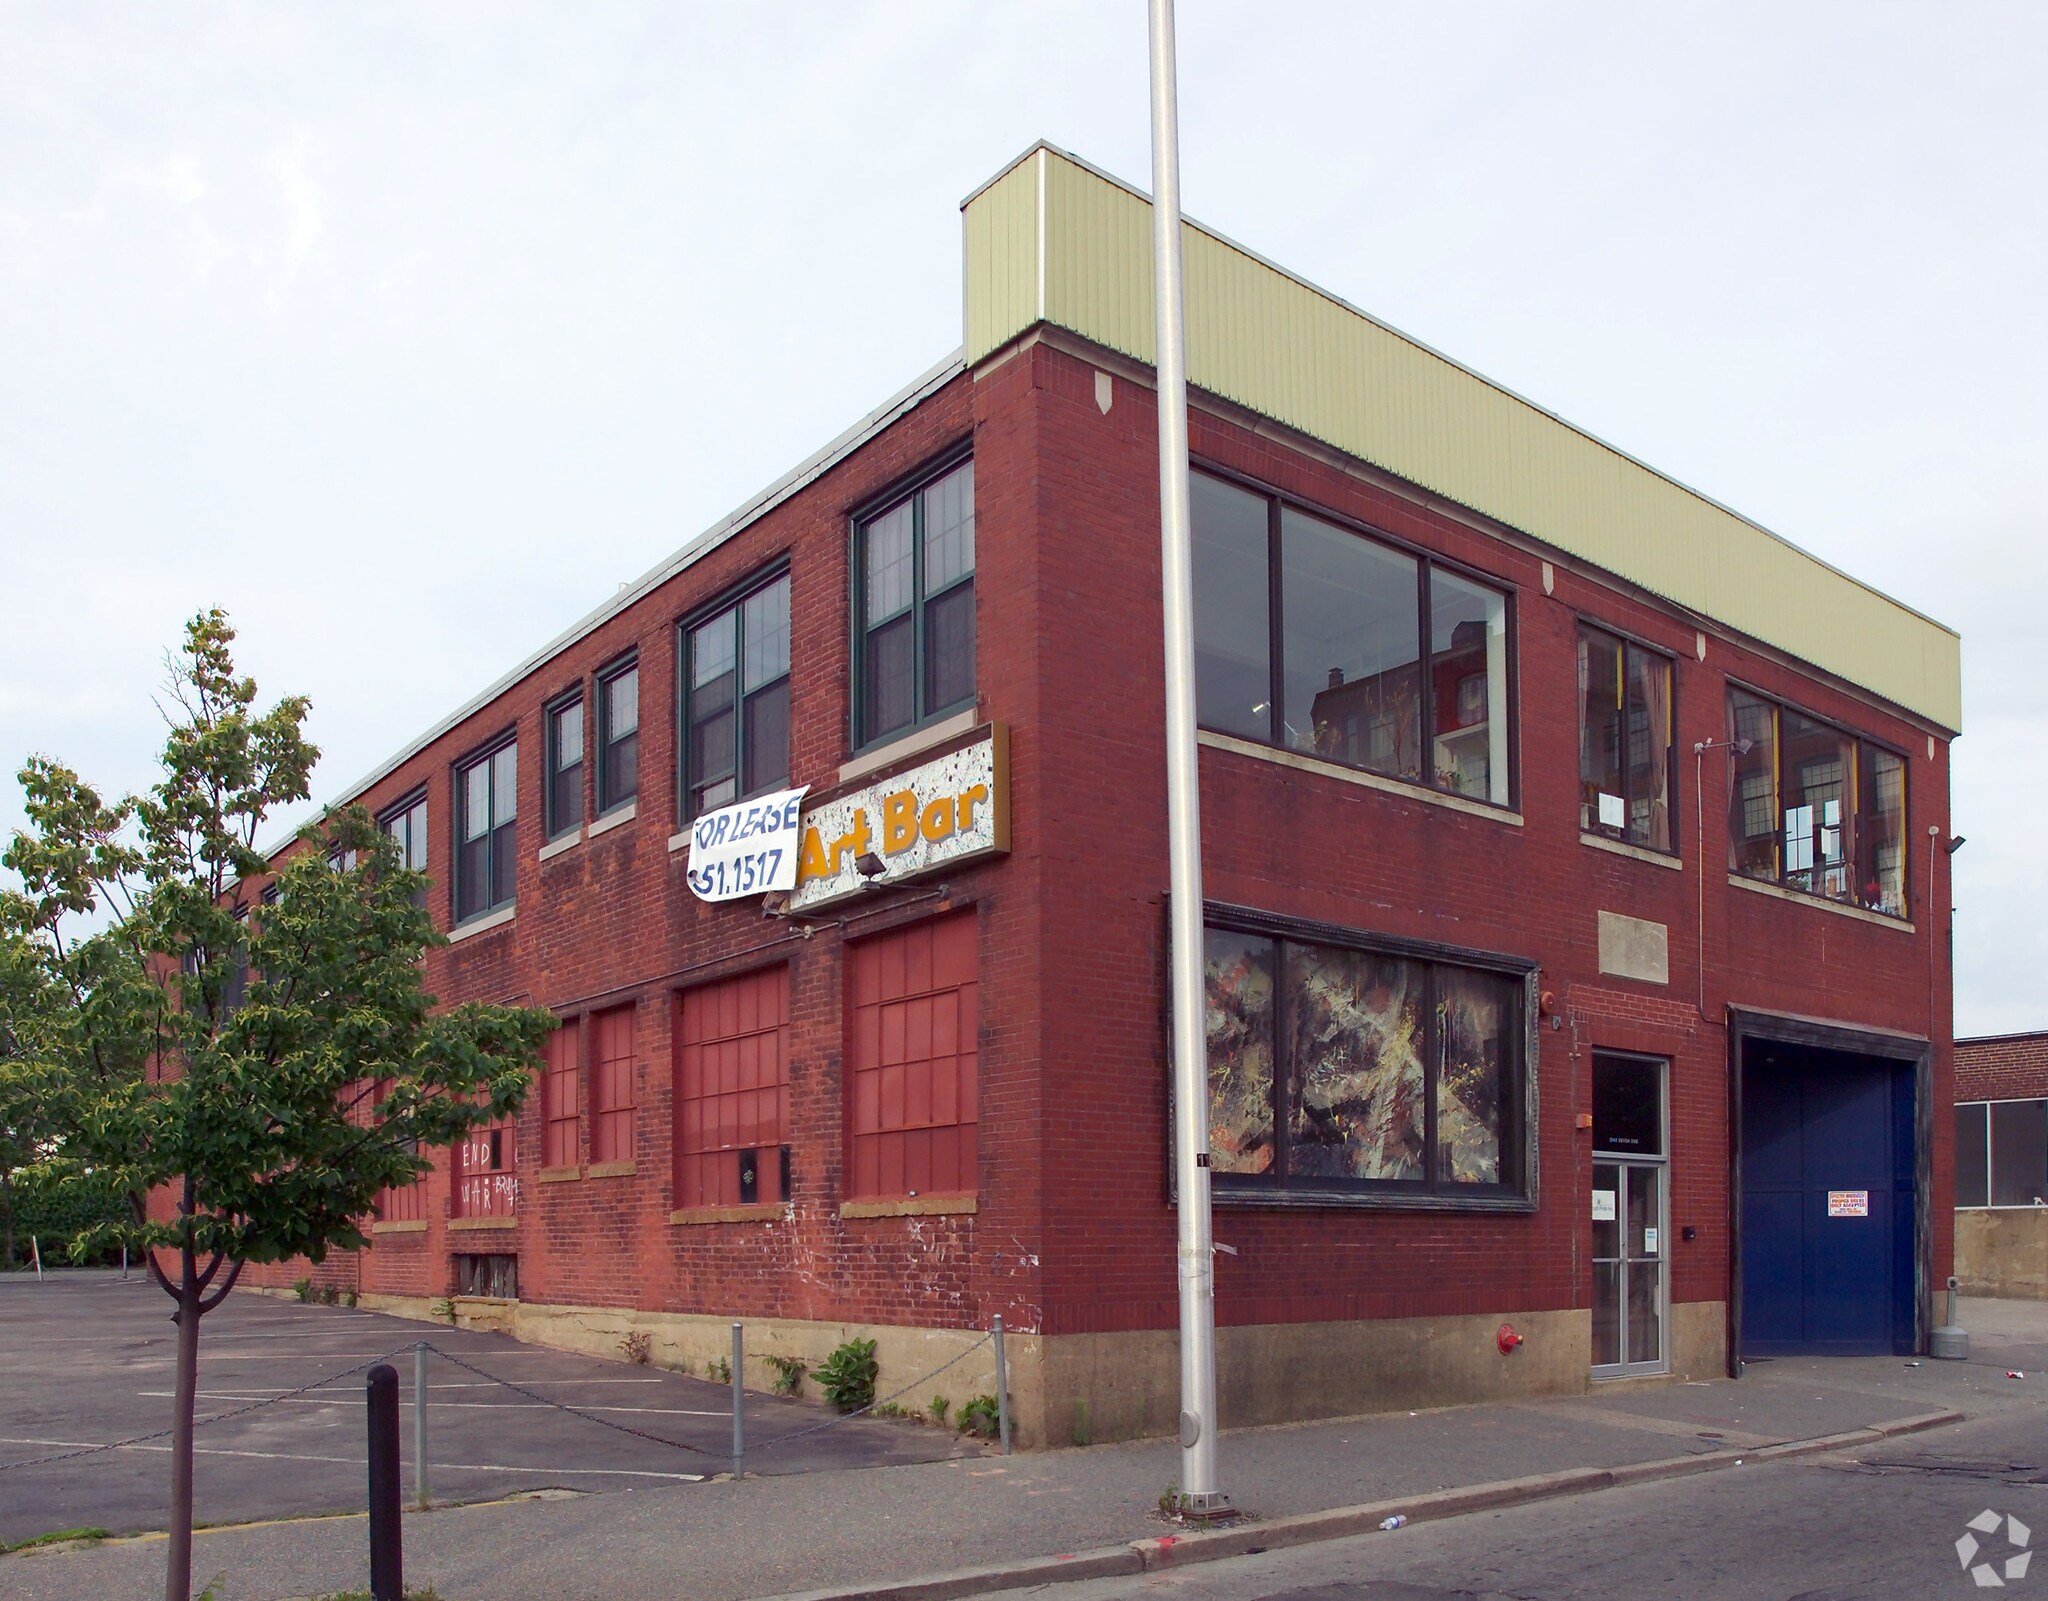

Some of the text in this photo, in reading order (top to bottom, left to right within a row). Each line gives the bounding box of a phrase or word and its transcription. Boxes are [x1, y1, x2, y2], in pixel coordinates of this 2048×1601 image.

[728, 795, 801, 842] LEASE
[797, 783, 989, 882] Art Bar
[462, 1143, 490, 1167] END
[461, 1180, 491, 1210] WAR
